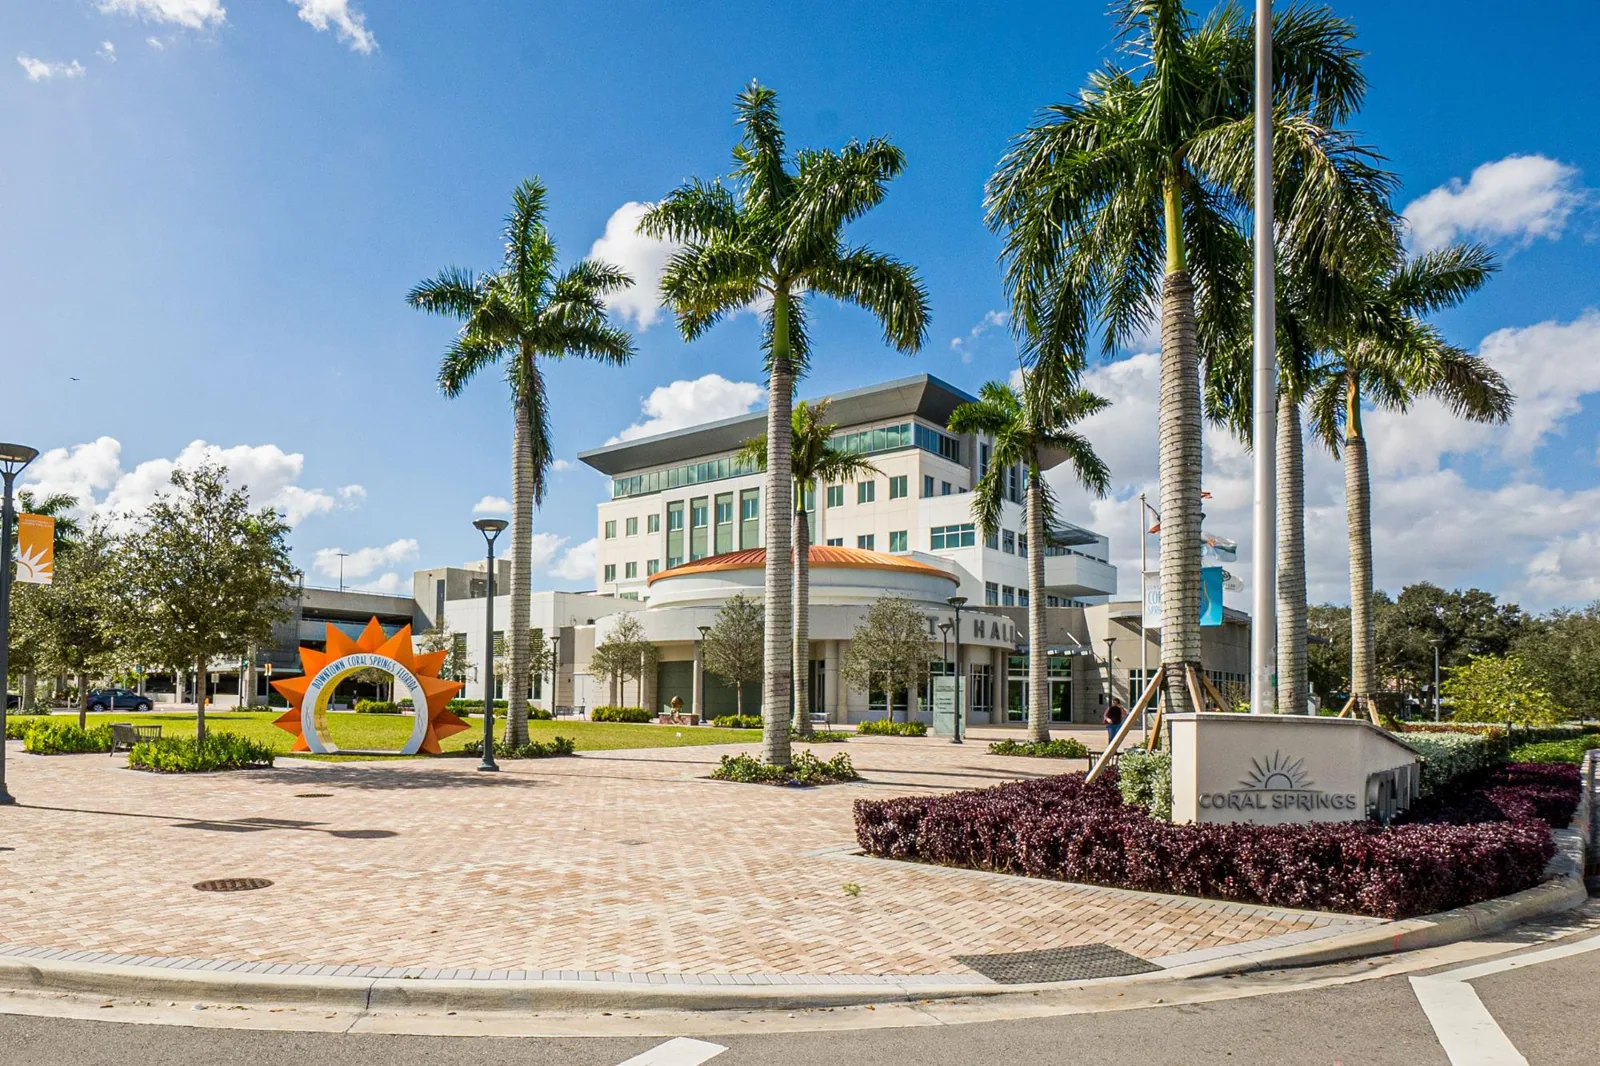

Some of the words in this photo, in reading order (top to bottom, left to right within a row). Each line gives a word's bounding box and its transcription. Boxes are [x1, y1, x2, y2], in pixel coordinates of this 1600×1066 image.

[973, 618, 1015, 643] HALL
[312, 661, 345, 689] DOWNTOWN
[347, 656, 367, 666] CORAL
[369, 656, 396, 671] SPRINGS
[396, 668, 418, 691] FLORIDA
[1199, 792, 1268, 811] CORAL
[1271, 792, 1357, 811] SPRINGS
